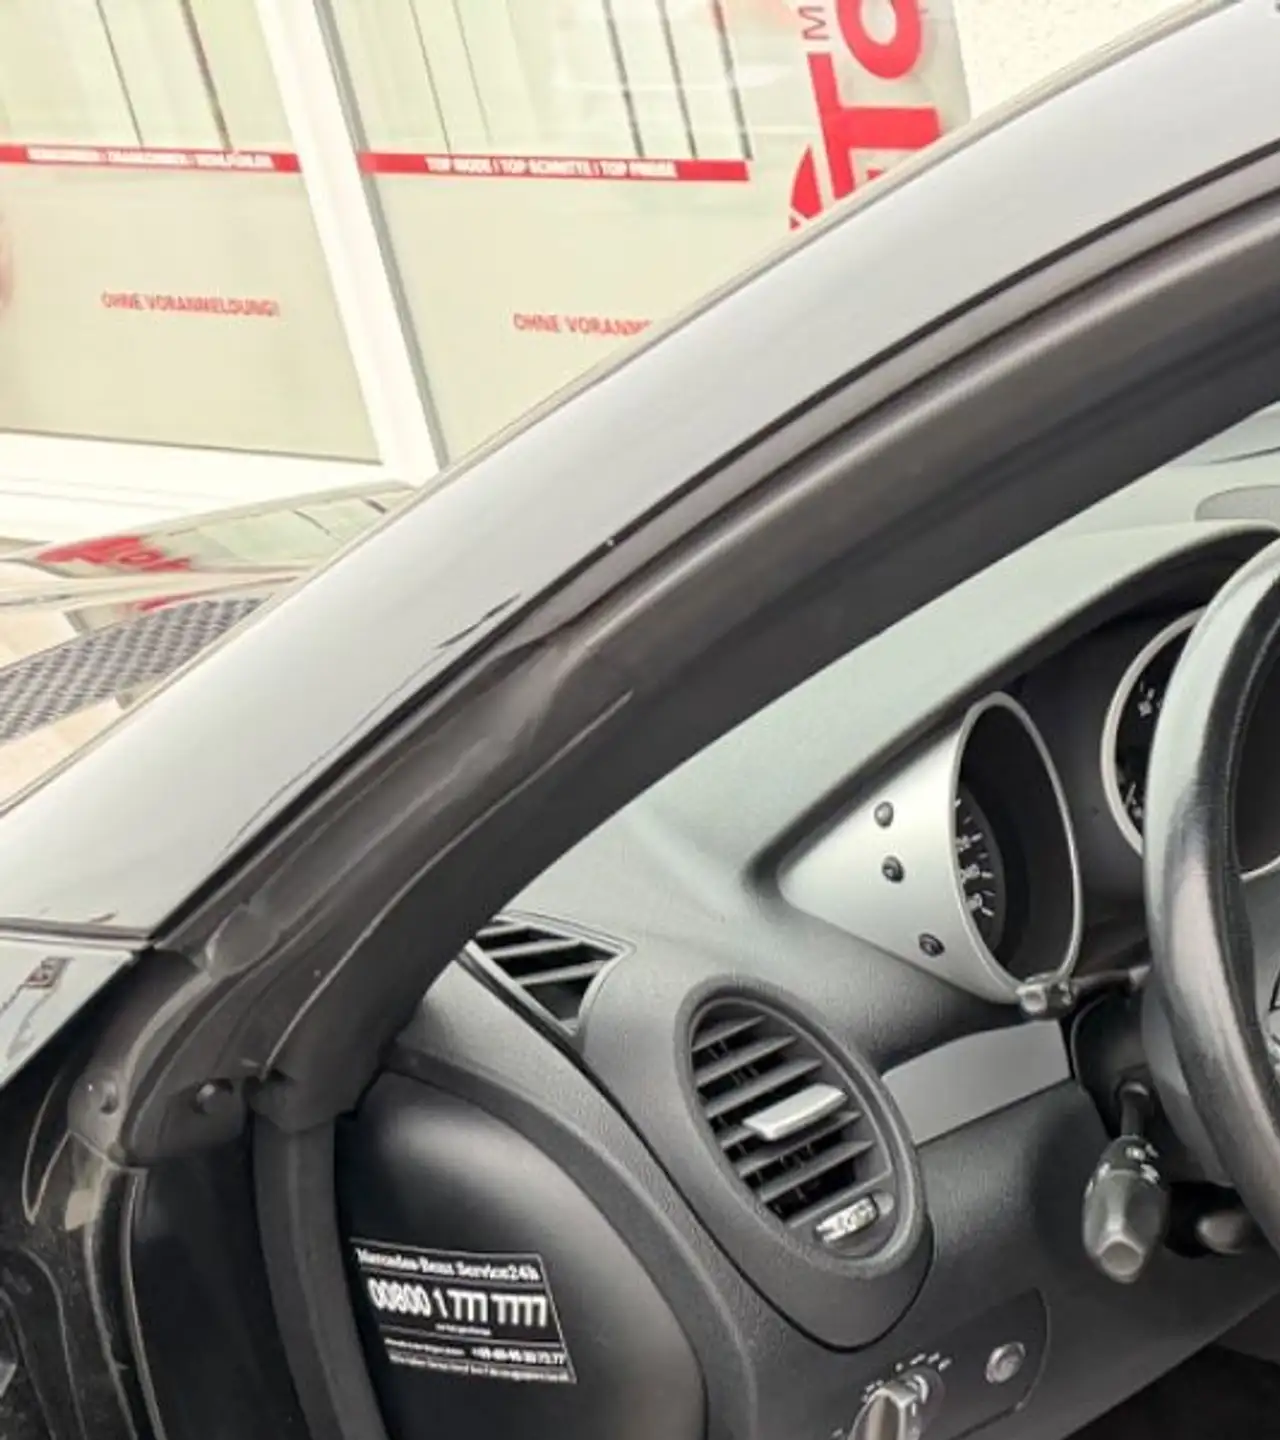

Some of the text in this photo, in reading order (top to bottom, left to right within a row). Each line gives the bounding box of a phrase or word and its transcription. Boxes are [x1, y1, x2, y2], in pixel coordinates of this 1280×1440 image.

[102, 291, 143, 310] OHNE
[513, 313, 560, 332] OHNE
[446, 1288, 489, 1322] 777
[490, 1293, 548, 1328] 7777
